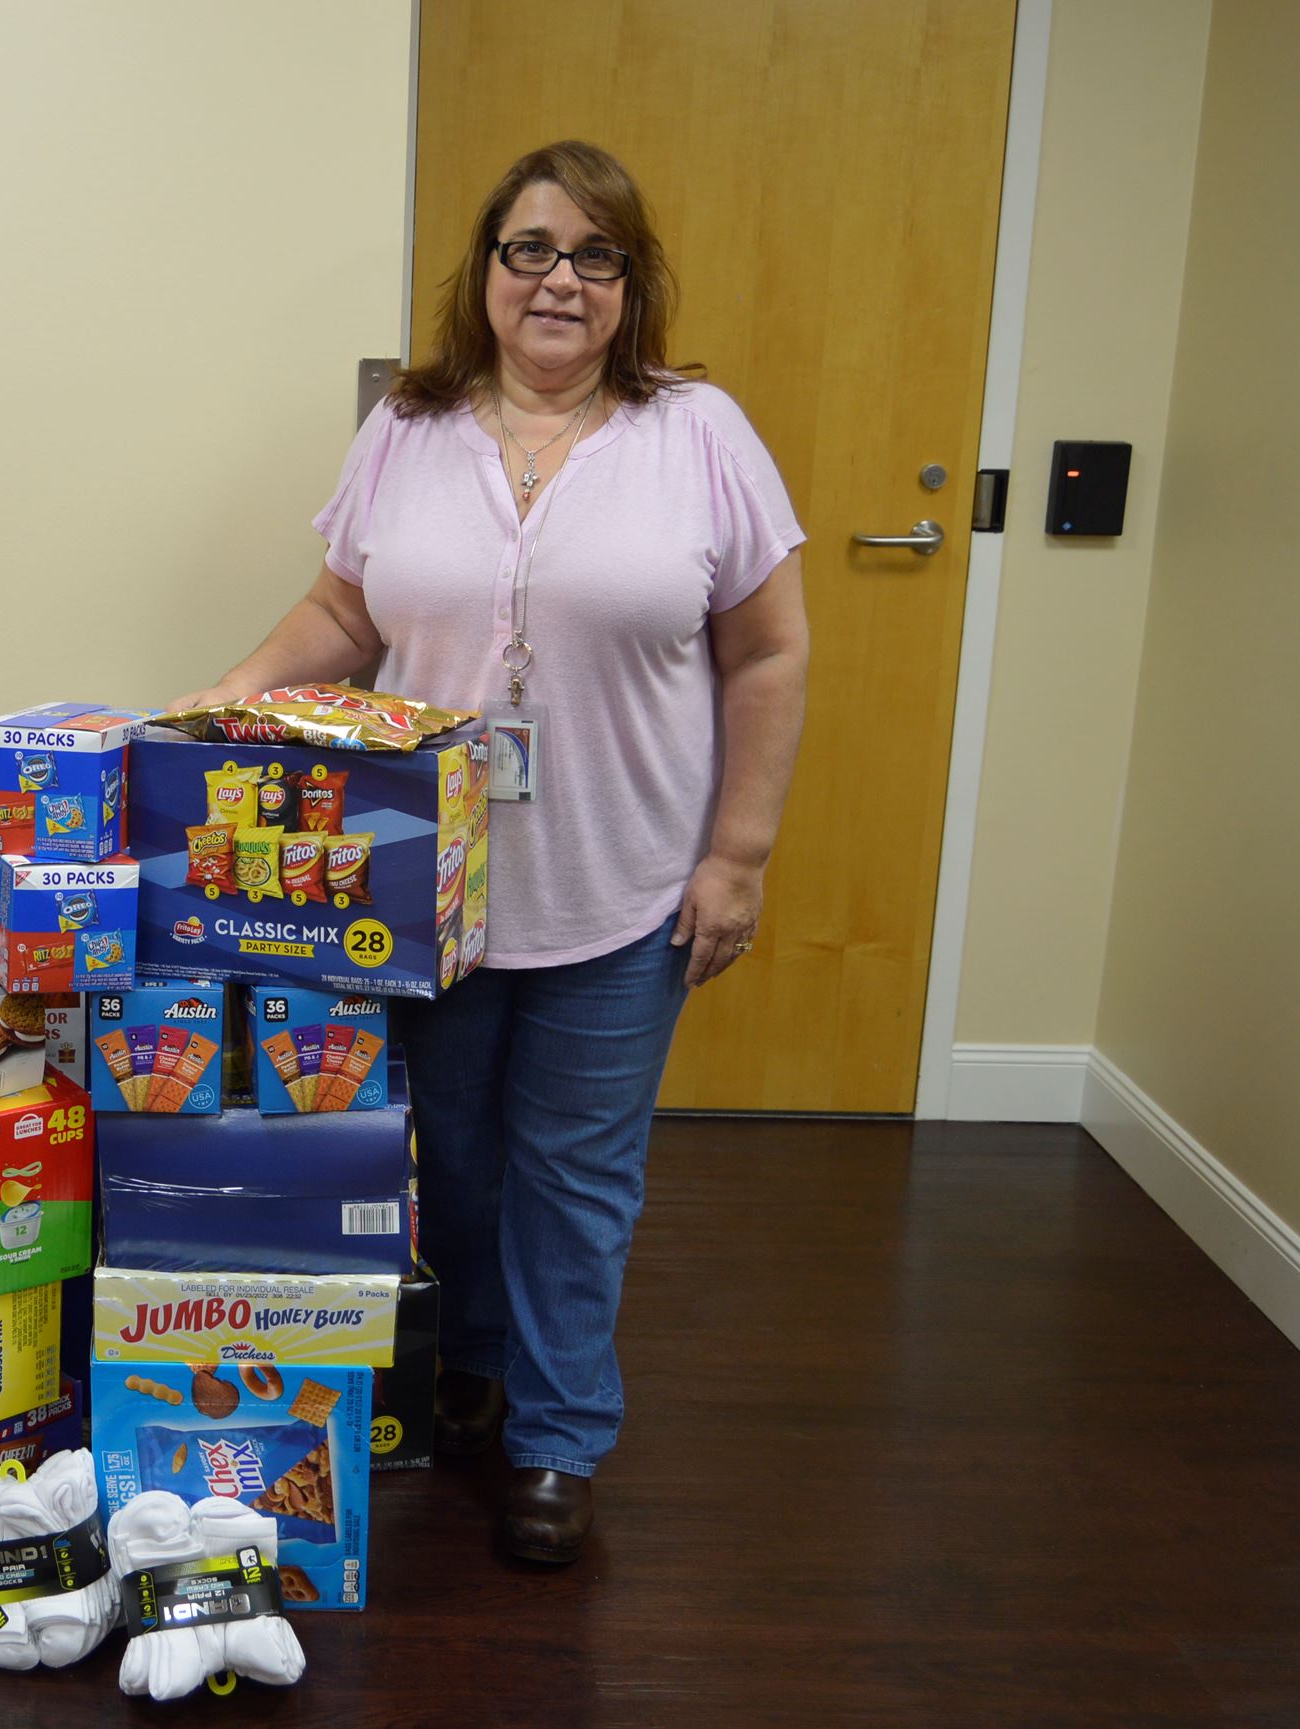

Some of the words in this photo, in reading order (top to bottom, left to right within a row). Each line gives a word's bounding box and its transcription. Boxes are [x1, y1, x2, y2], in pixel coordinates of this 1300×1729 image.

[3, 730, 22, 744] 30
[27, 732, 75, 747] PACKS
[303, 729, 327, 740] BIG
[23, 763, 51, 774] OREO
[227, 765, 233, 773] 4
[273, 766, 279, 775] 3
[316, 768, 323, 777] 5
[217, 786, 244, 803] Lay's
[302, 788, 333, 799] Doritos
[193, 830, 227, 853] Cheetos
[283, 844, 317, 866] Fritos
[328, 846, 364, 869] Fritos
[437, 840, 466, 893] Fritos
[42, 872, 61, 885] 30
[67, 871, 115, 885] PACKS
[209, 888, 215, 896] 5
[252, 891, 259, 899] 3
[296, 894, 302, 903] 5
[63, 902, 92, 914] OREO
[338, 897, 345, 906] 3
[215, 918, 296, 940] CLASSIC
[303, 925, 339, 944] MIX
[351, 929, 385, 953] 28
[33, 949, 49, 962] RITZ
[246, 942, 280, 954] PARTY
[284, 945, 307, 955] SIZE
[461, 921, 485, 976] Fritos
[101, 999, 120, 1011] 36
[164, 1003, 217, 1019] Austin
[266, 1001, 285, 1013] 36
[329, 1000, 381, 1017] Austin
[192, 1092, 211, 1102] USA
[360, 1088, 379, 1099] USA
[47, 1105, 86, 1131] 48
[16, 1123, 31, 1131] GREAT
[31, 1121, 42, 1129] FOR
[16, 1126, 41, 1136] LUNCHES
[50, 1128, 84, 1145] CUPS
[15, 1225, 27, 1237] 12
[17, 1245, 43, 1259] CREAM
[181, 1284, 216, 1293] LABELED
[218, 1285, 235, 1293] FOR
[237, 1285, 281, 1294] INDIVIDUAL
[283, 1286, 314, 1294] RESALE
[358, 1290, 364, 1298] 9
[365, 1290, 390, 1298] Packs
[120, 1297, 251, 1343] JUMBO
[255, 1307, 314, 1331] HONEY
[313, 1308, 365, 1330] BUNS
[220, 1346, 276, 1361] Duchess
[49, 1400, 73, 1418] PACKS
[27, 1406, 48, 1428] 38
[371, 1424, 397, 1443] 28
[108, 1453, 121, 1469] 1.75
[221, 1440, 265, 1492] mix
[197, 1438, 241, 1499] Chex
[106, 1474, 119, 1499] SERVE
[118, 1474, 137, 1511] GS!
[2, 1564, 26, 1573] PAIR
[187, 1591, 213, 1600] PAIR
